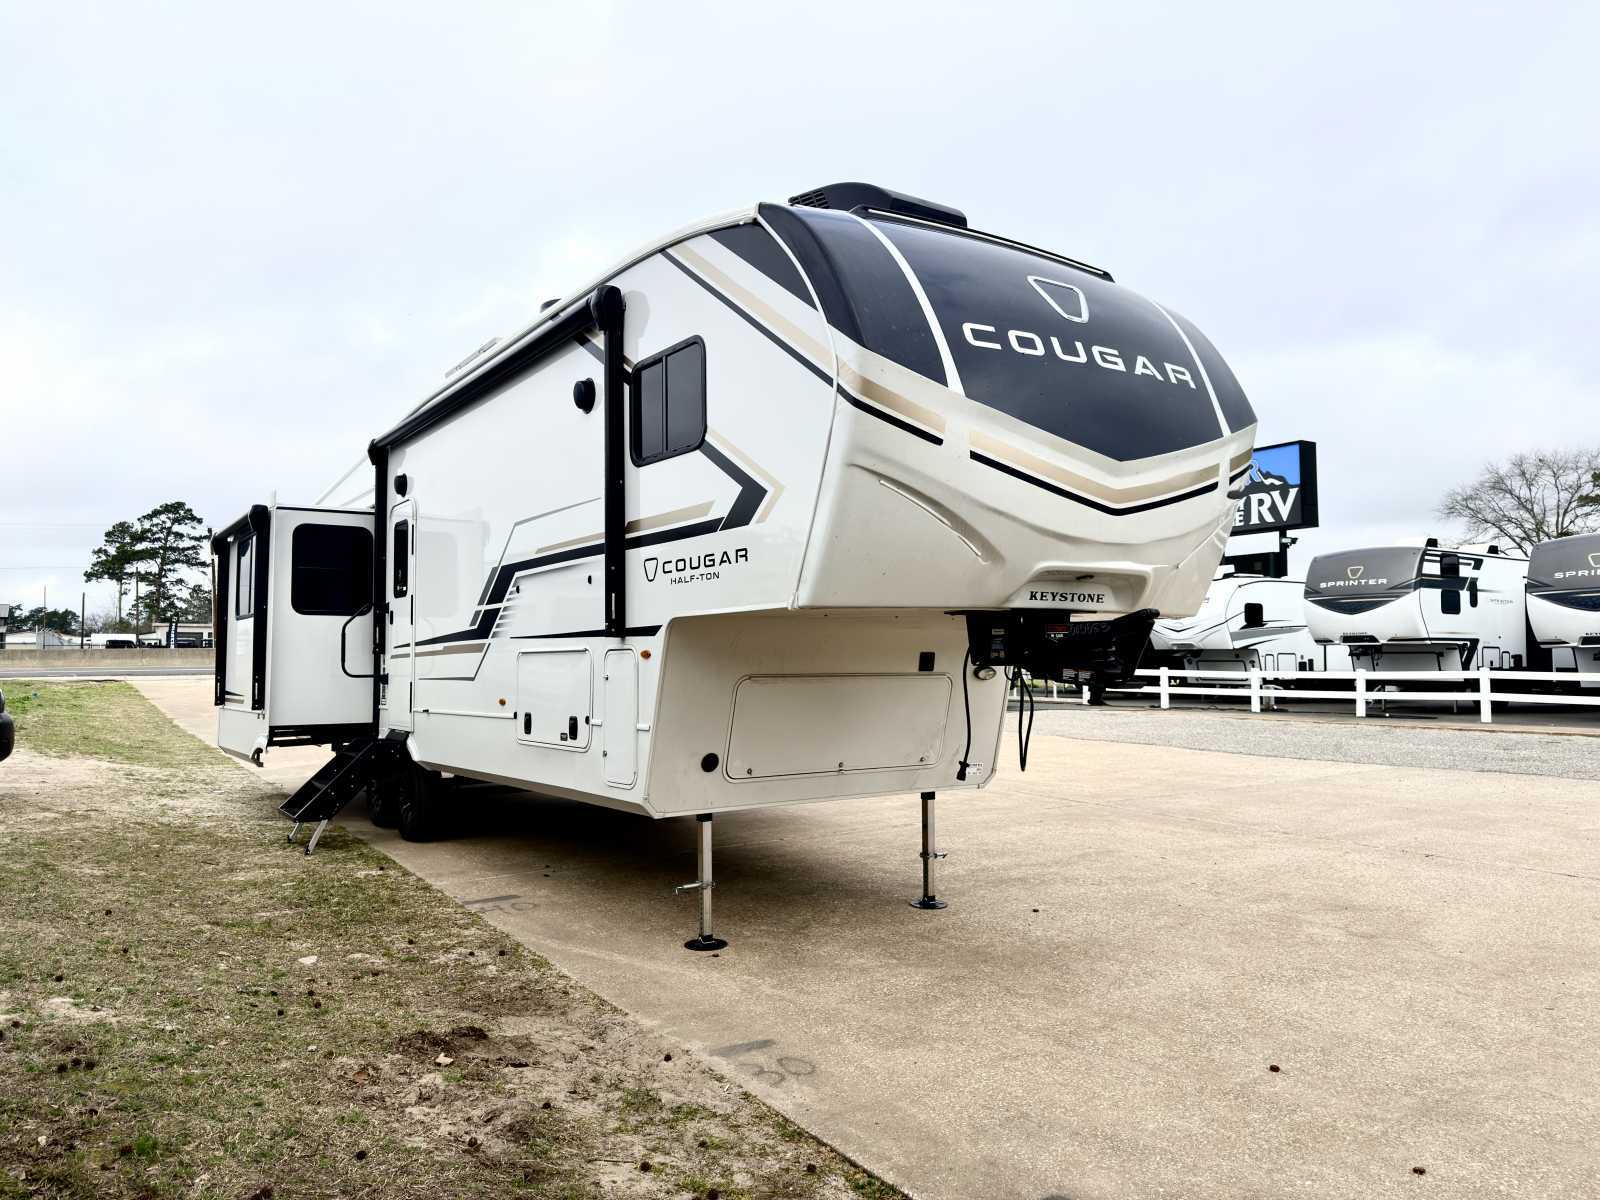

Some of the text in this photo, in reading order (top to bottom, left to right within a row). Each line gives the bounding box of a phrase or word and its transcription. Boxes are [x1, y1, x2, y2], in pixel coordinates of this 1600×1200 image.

[962, 322, 1197, 390] COUGAR
[1248, 487, 1299, 525] RV
[662, 547, 749, 575] COUGAR
[670, 571, 720, 585] HALF-TON
[1319, 578, 1388, 589] SPRINTER
[1028, 591, 1105, 604] KEYSTONE
